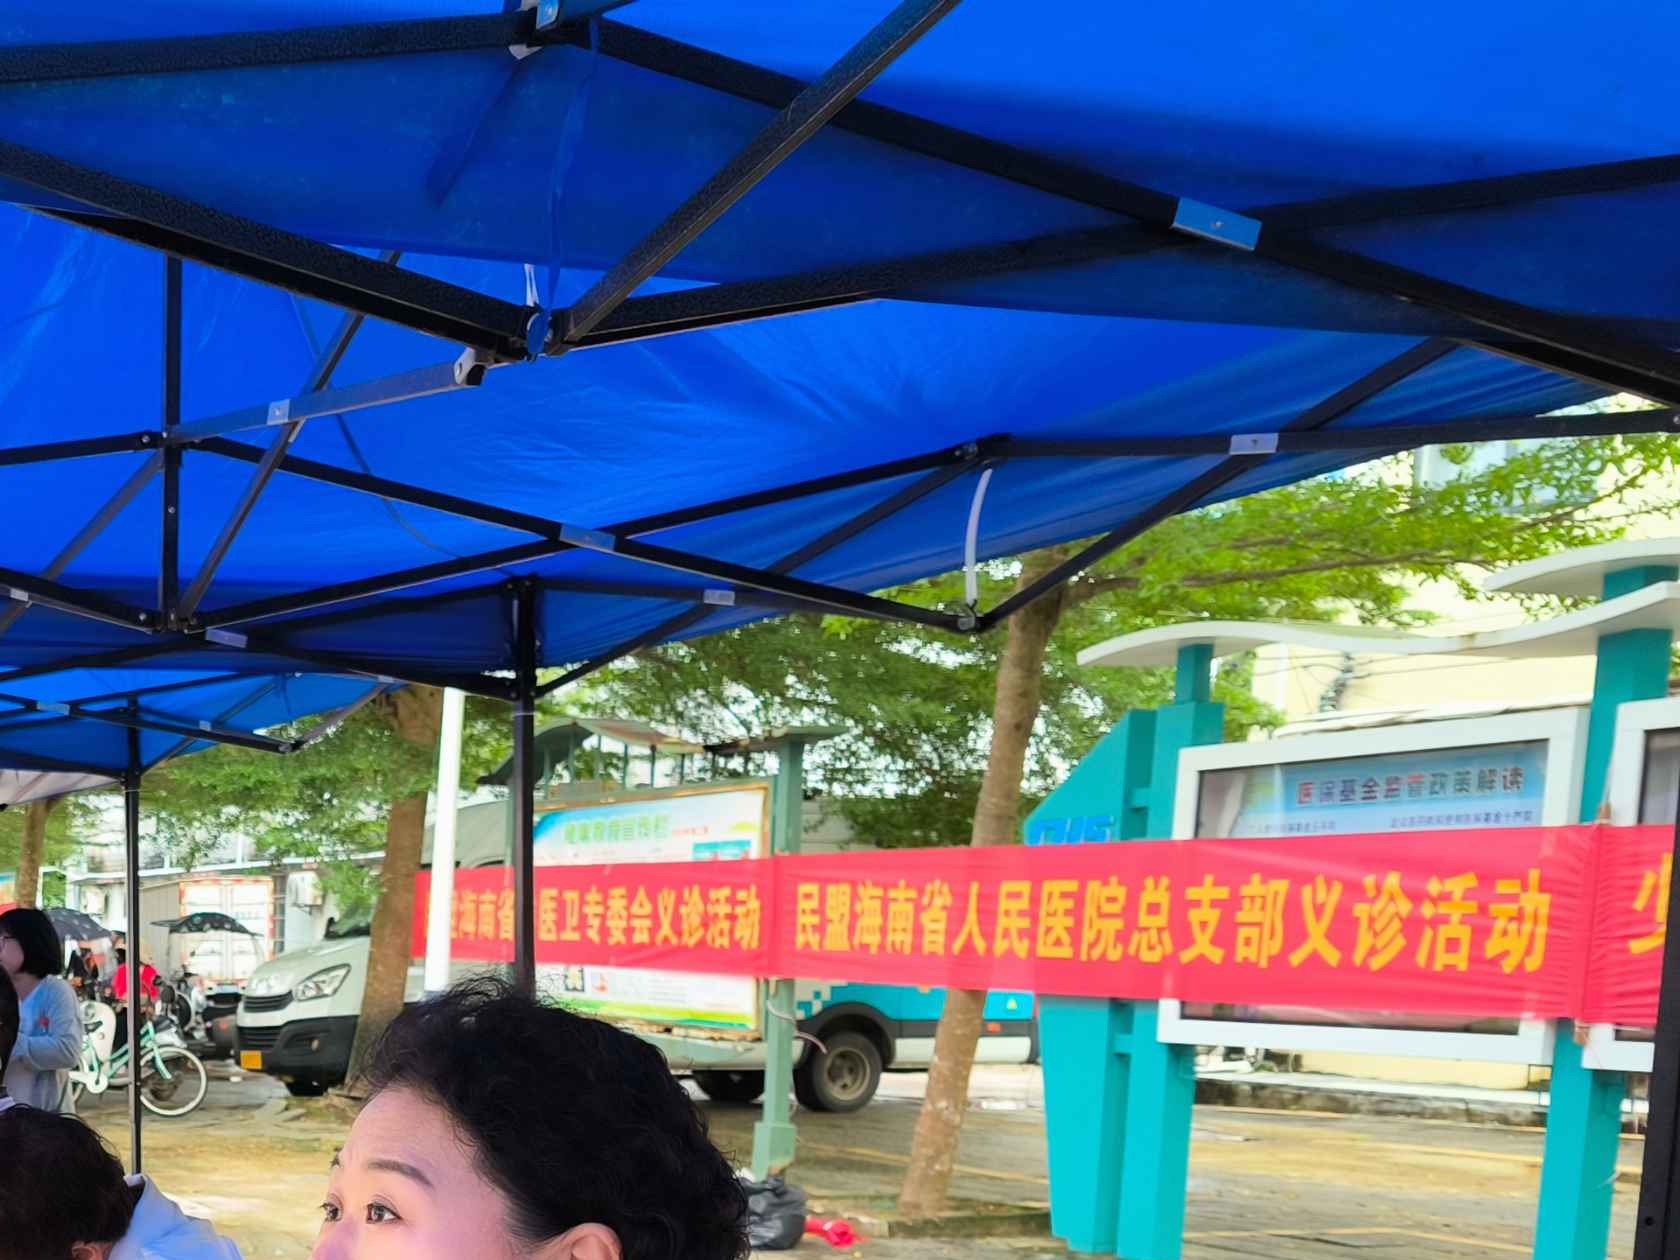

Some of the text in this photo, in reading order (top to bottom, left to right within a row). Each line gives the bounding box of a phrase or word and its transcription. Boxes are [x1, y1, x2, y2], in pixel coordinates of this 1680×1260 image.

[425, 884, 761, 950] 海南省医卫专委会义诊活动
[794, 868, 1552, 974] 民盟海南省人民医院总支部义诊活动
